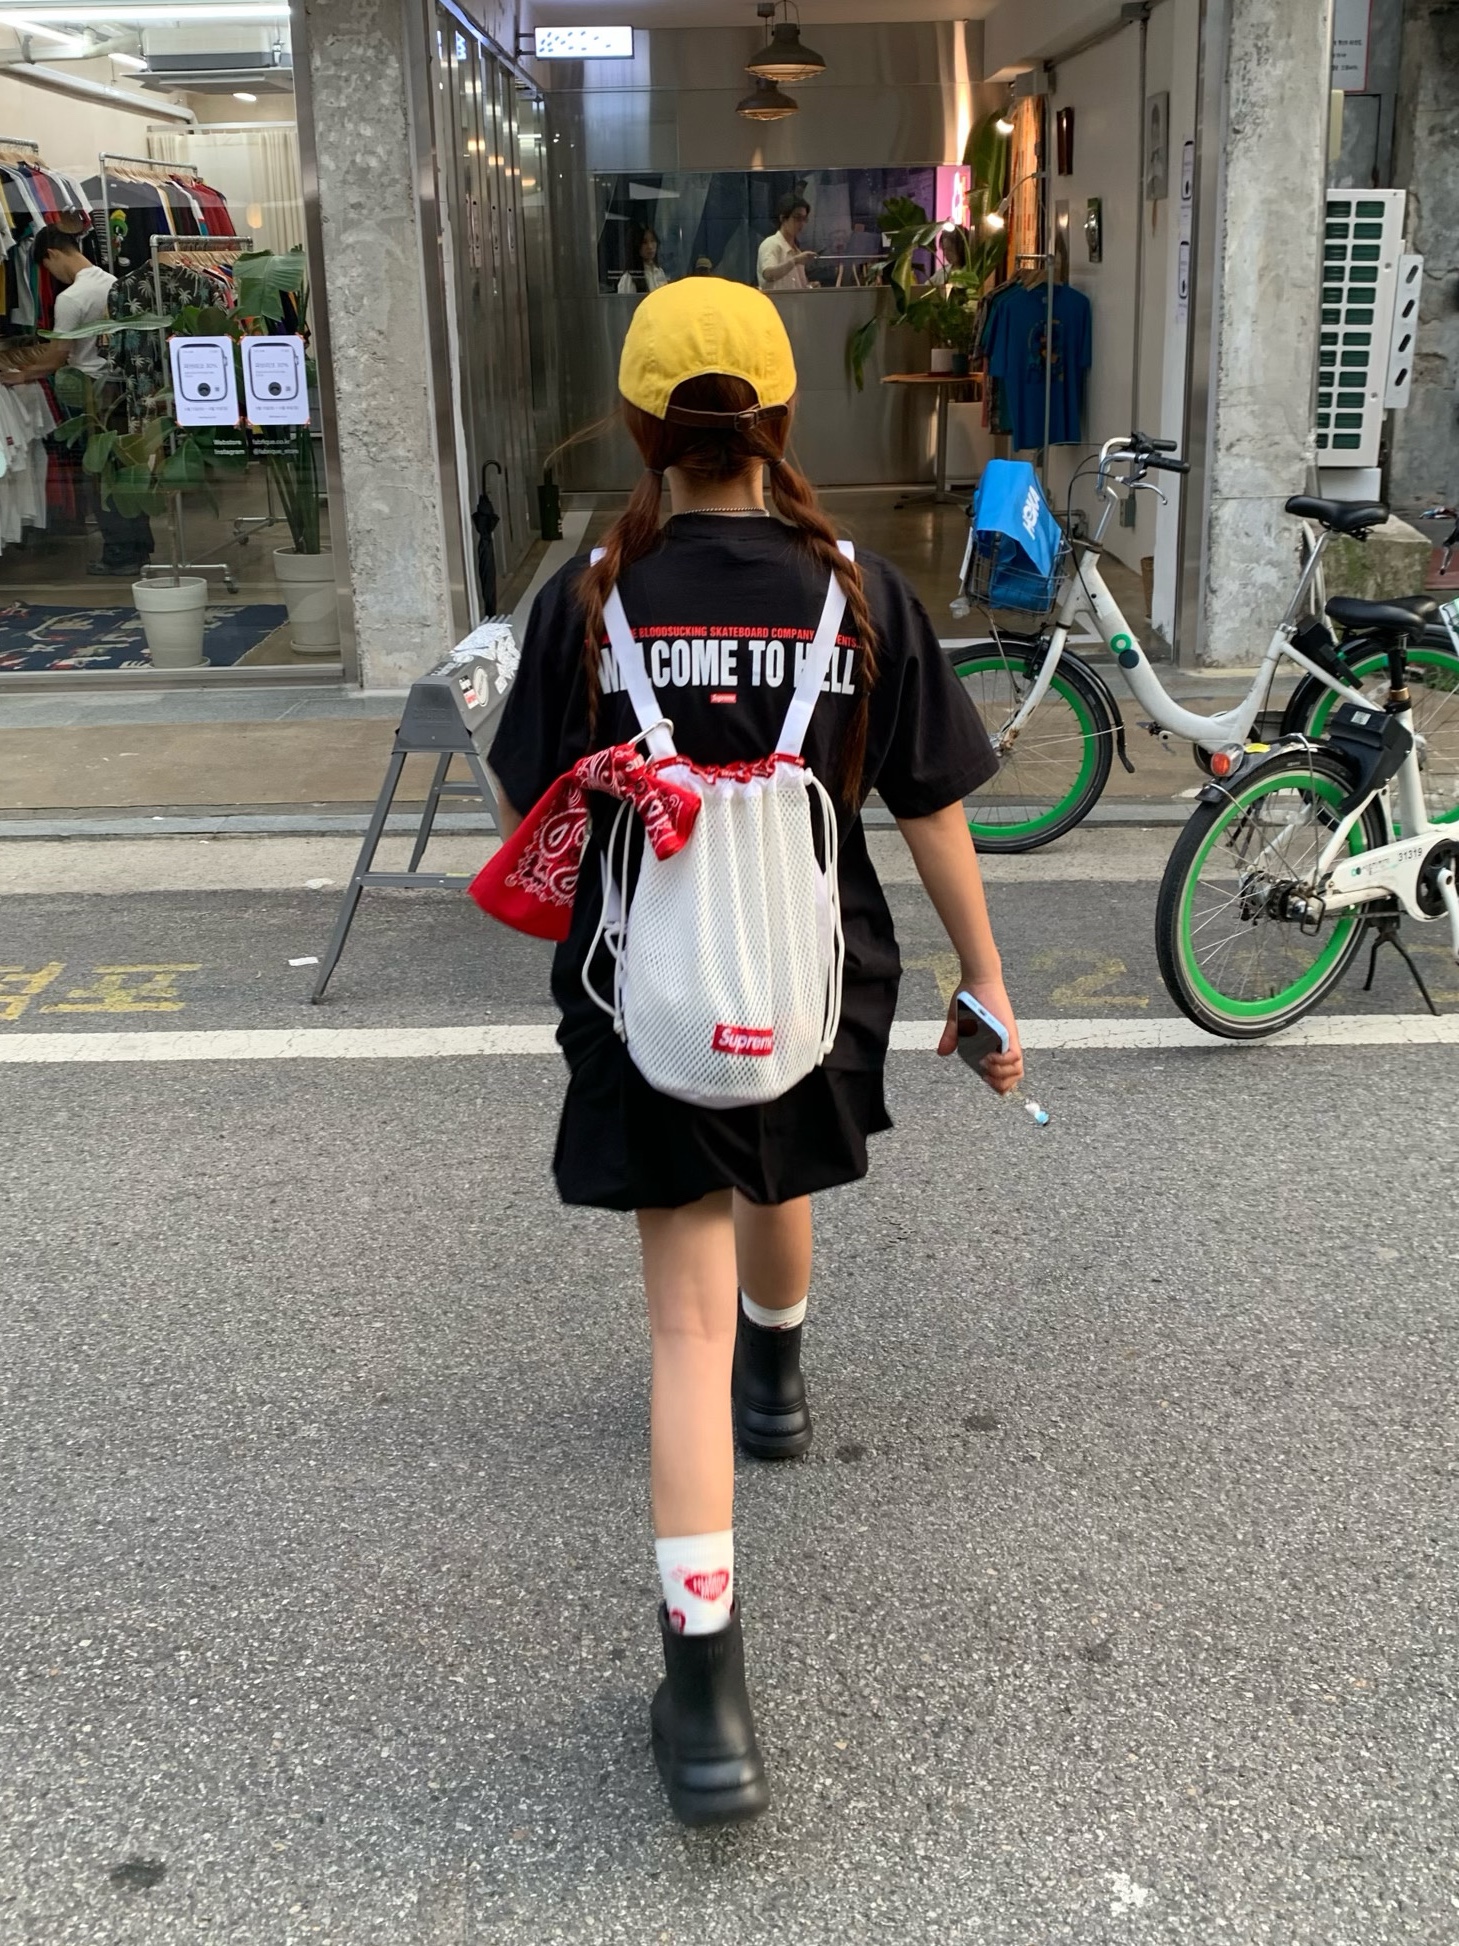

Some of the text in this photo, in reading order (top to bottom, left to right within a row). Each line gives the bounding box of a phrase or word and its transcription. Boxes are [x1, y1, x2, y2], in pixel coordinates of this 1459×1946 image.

[213, 448, 245, 456] Instagram
[638, 626, 707, 638] BLOODSUCKING
[710, 626, 769, 638] SKATEBOARD
[771, 627, 815, 640] COMPANY
[597, 639, 739, 695] WCOME
[748, 640, 785, 688] TO
[1398, 847, 1423, 862] 31319
